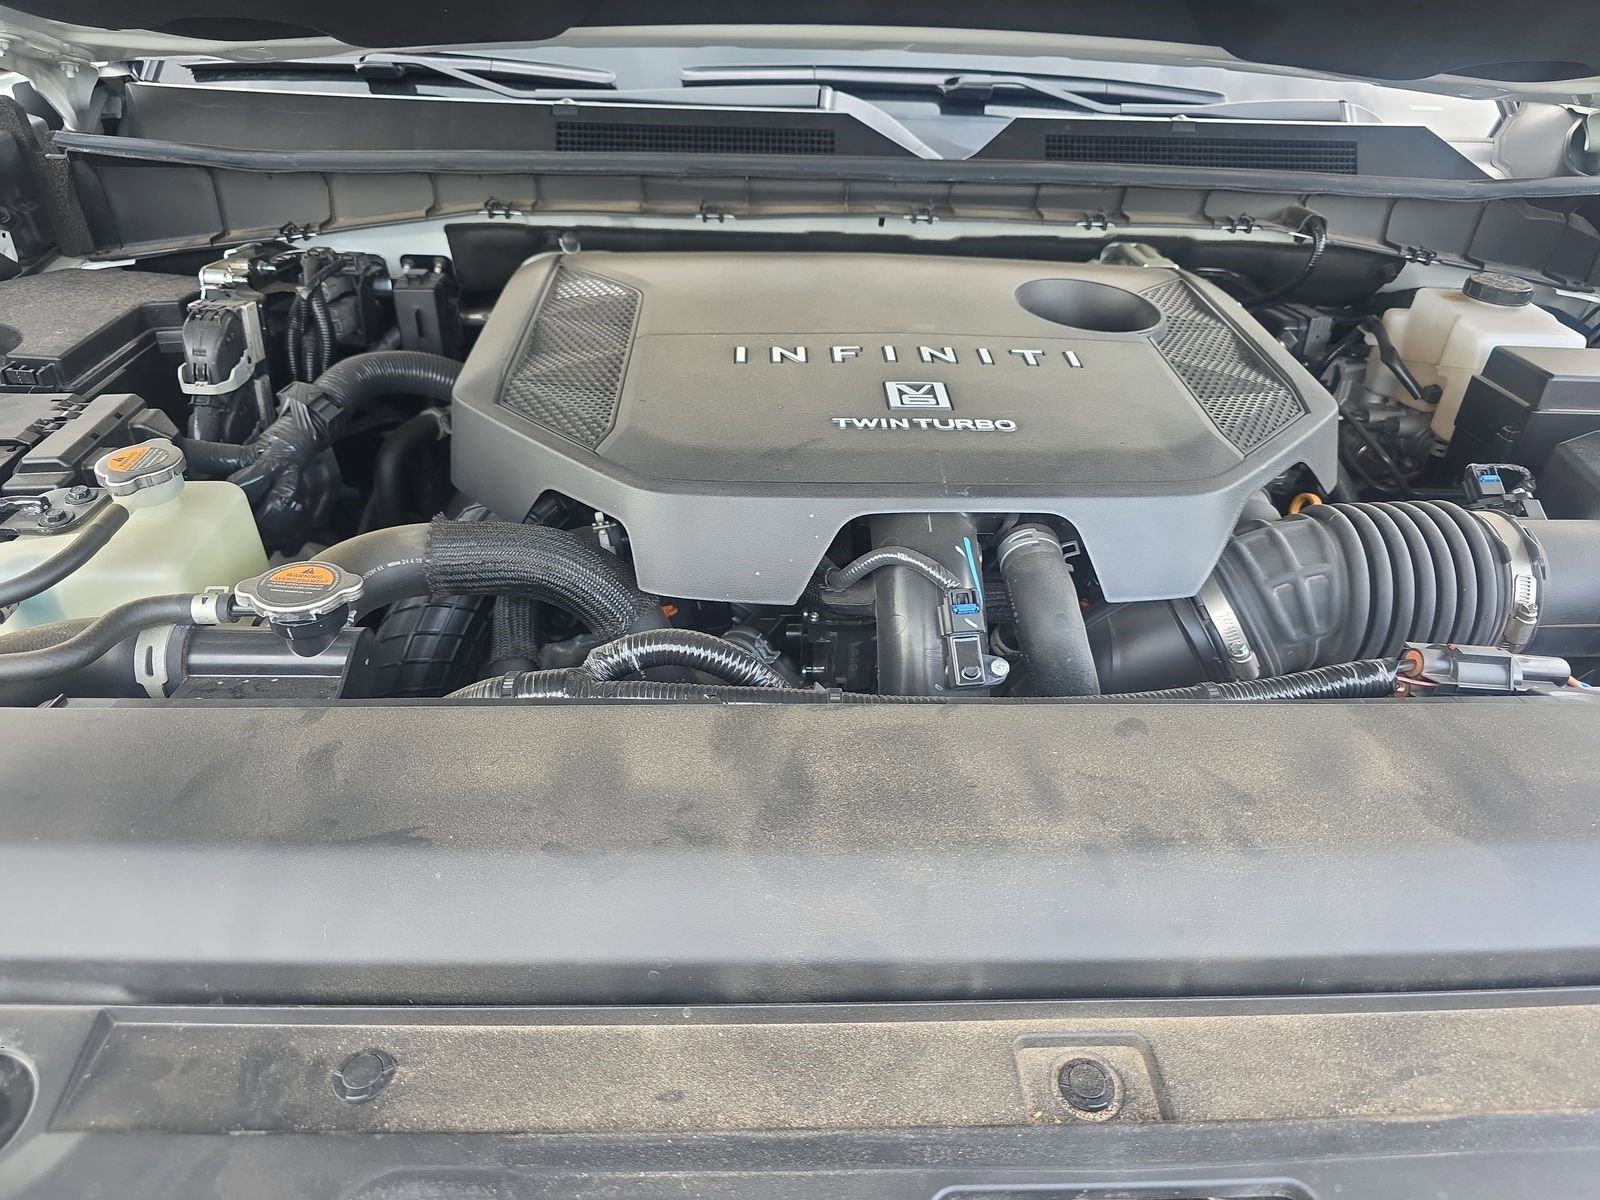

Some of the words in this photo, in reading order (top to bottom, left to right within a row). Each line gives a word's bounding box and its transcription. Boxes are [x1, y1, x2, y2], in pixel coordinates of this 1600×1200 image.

[733, 344, 1084, 368] INFINITI
[832, 417, 911, 431] TWIN
[911, 417, 1018, 433] TURBO
[286, 572, 324, 580] WARNING
